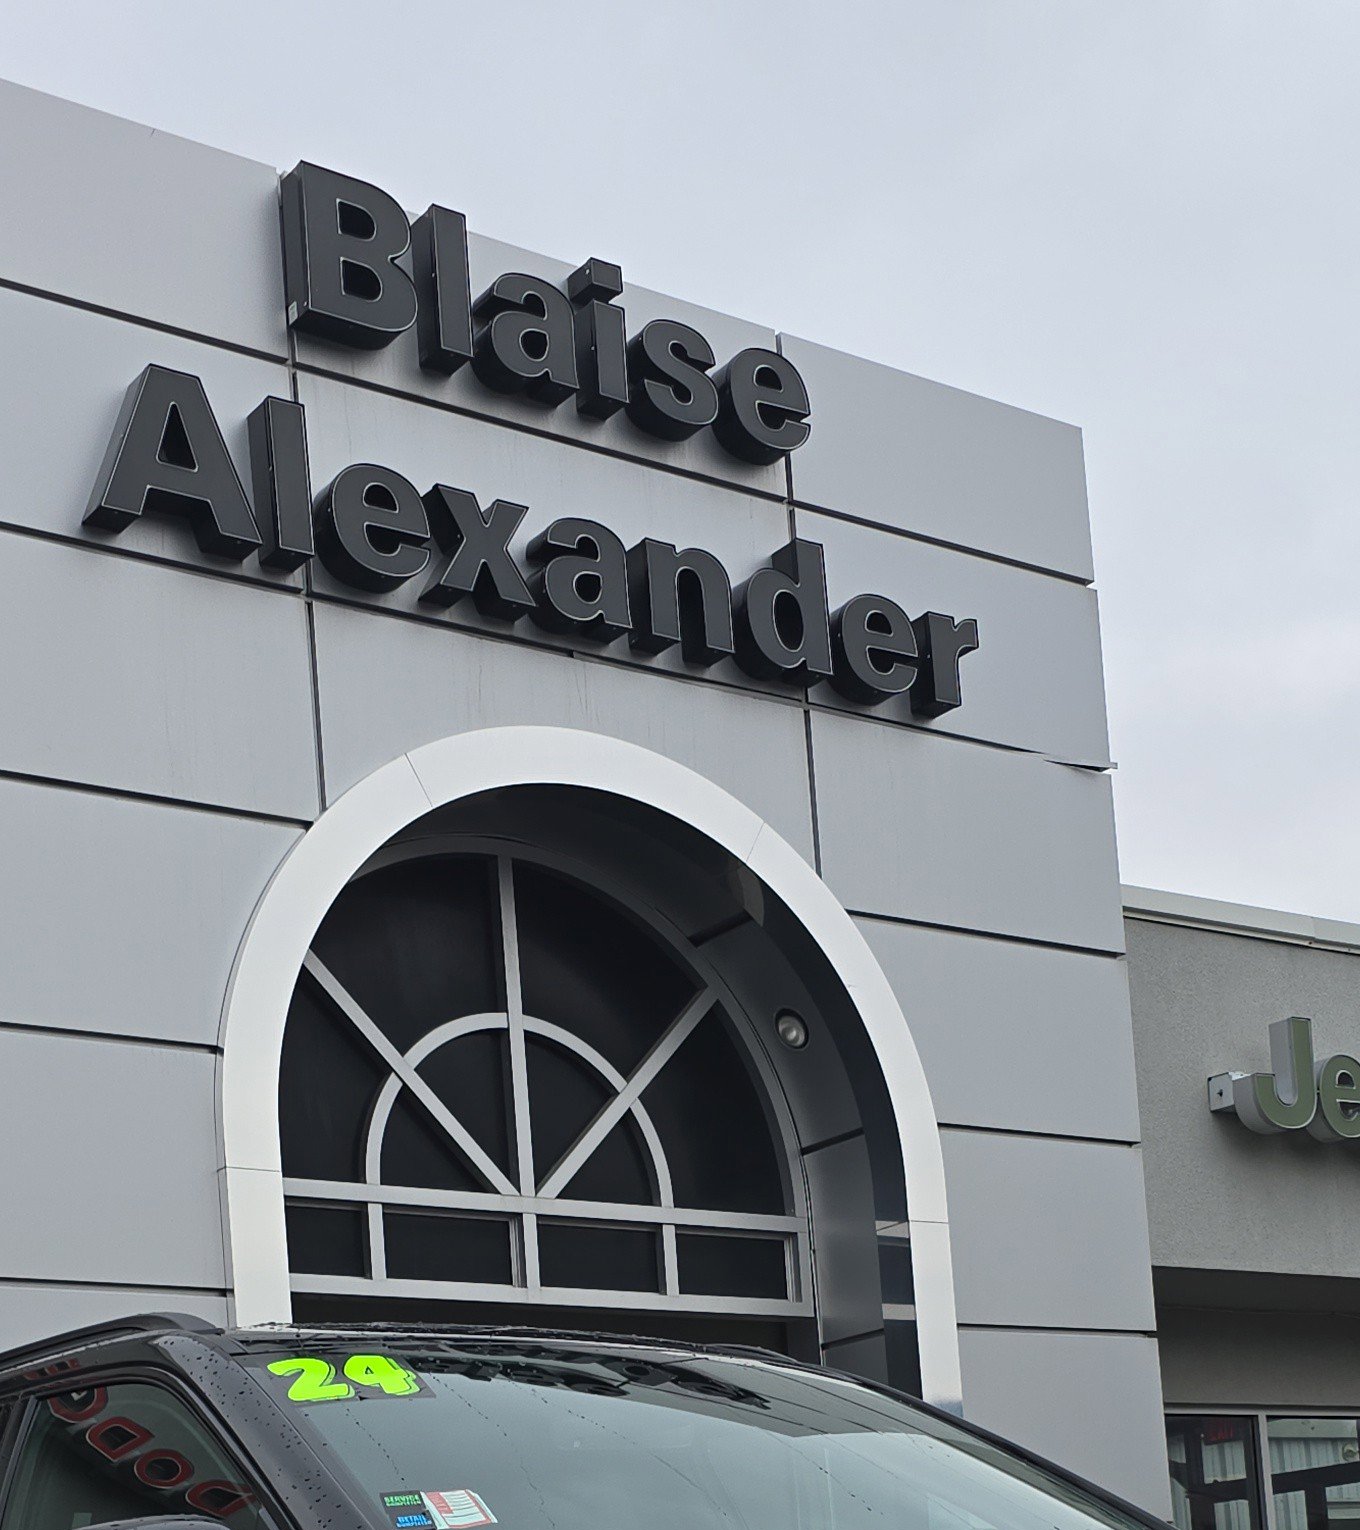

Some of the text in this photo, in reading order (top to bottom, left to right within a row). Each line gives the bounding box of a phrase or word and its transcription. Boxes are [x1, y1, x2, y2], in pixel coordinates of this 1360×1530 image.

[280, 161, 812, 465] Blaise
[83, 363, 978, 717] Alexander
[266, 1353, 421, 1402] 24
